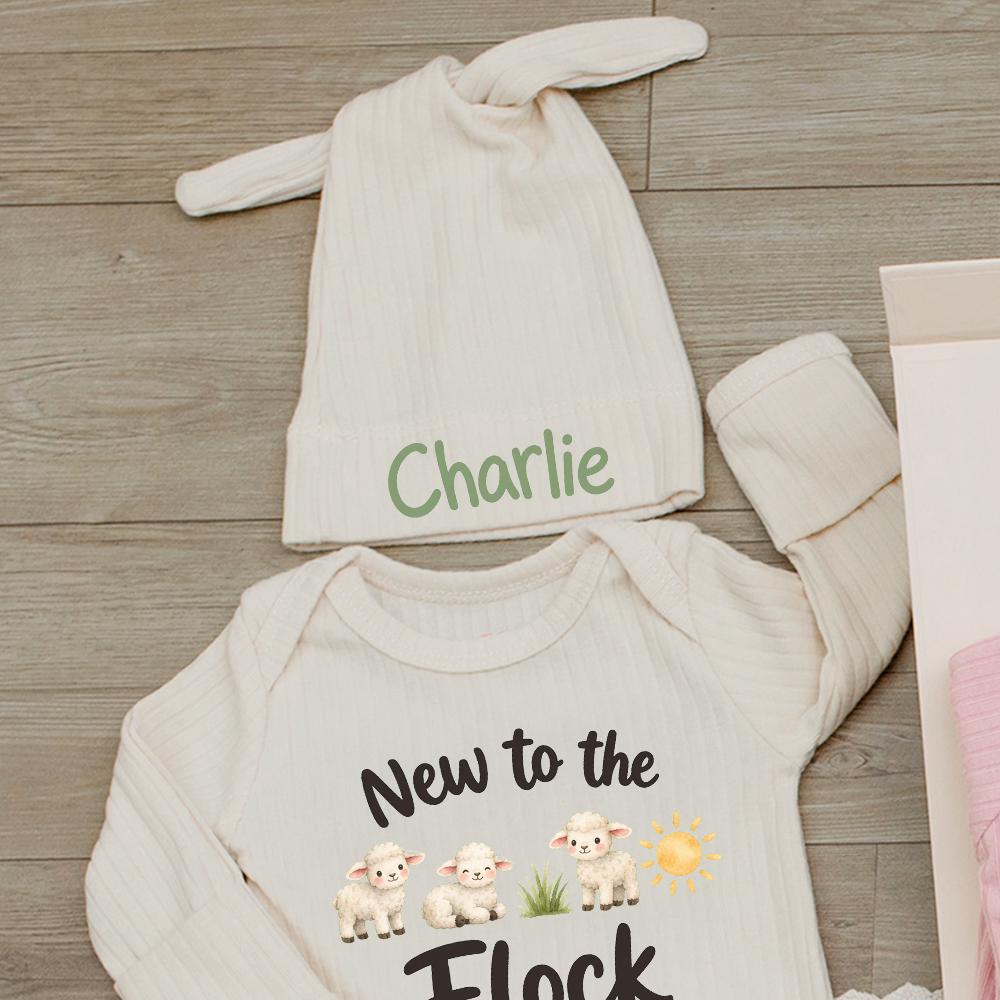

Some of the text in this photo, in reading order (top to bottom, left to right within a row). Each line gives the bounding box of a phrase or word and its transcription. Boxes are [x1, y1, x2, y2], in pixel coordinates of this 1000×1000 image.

[387, 428, 615, 518] Charlie
[361, 728, 660, 829] New to the
